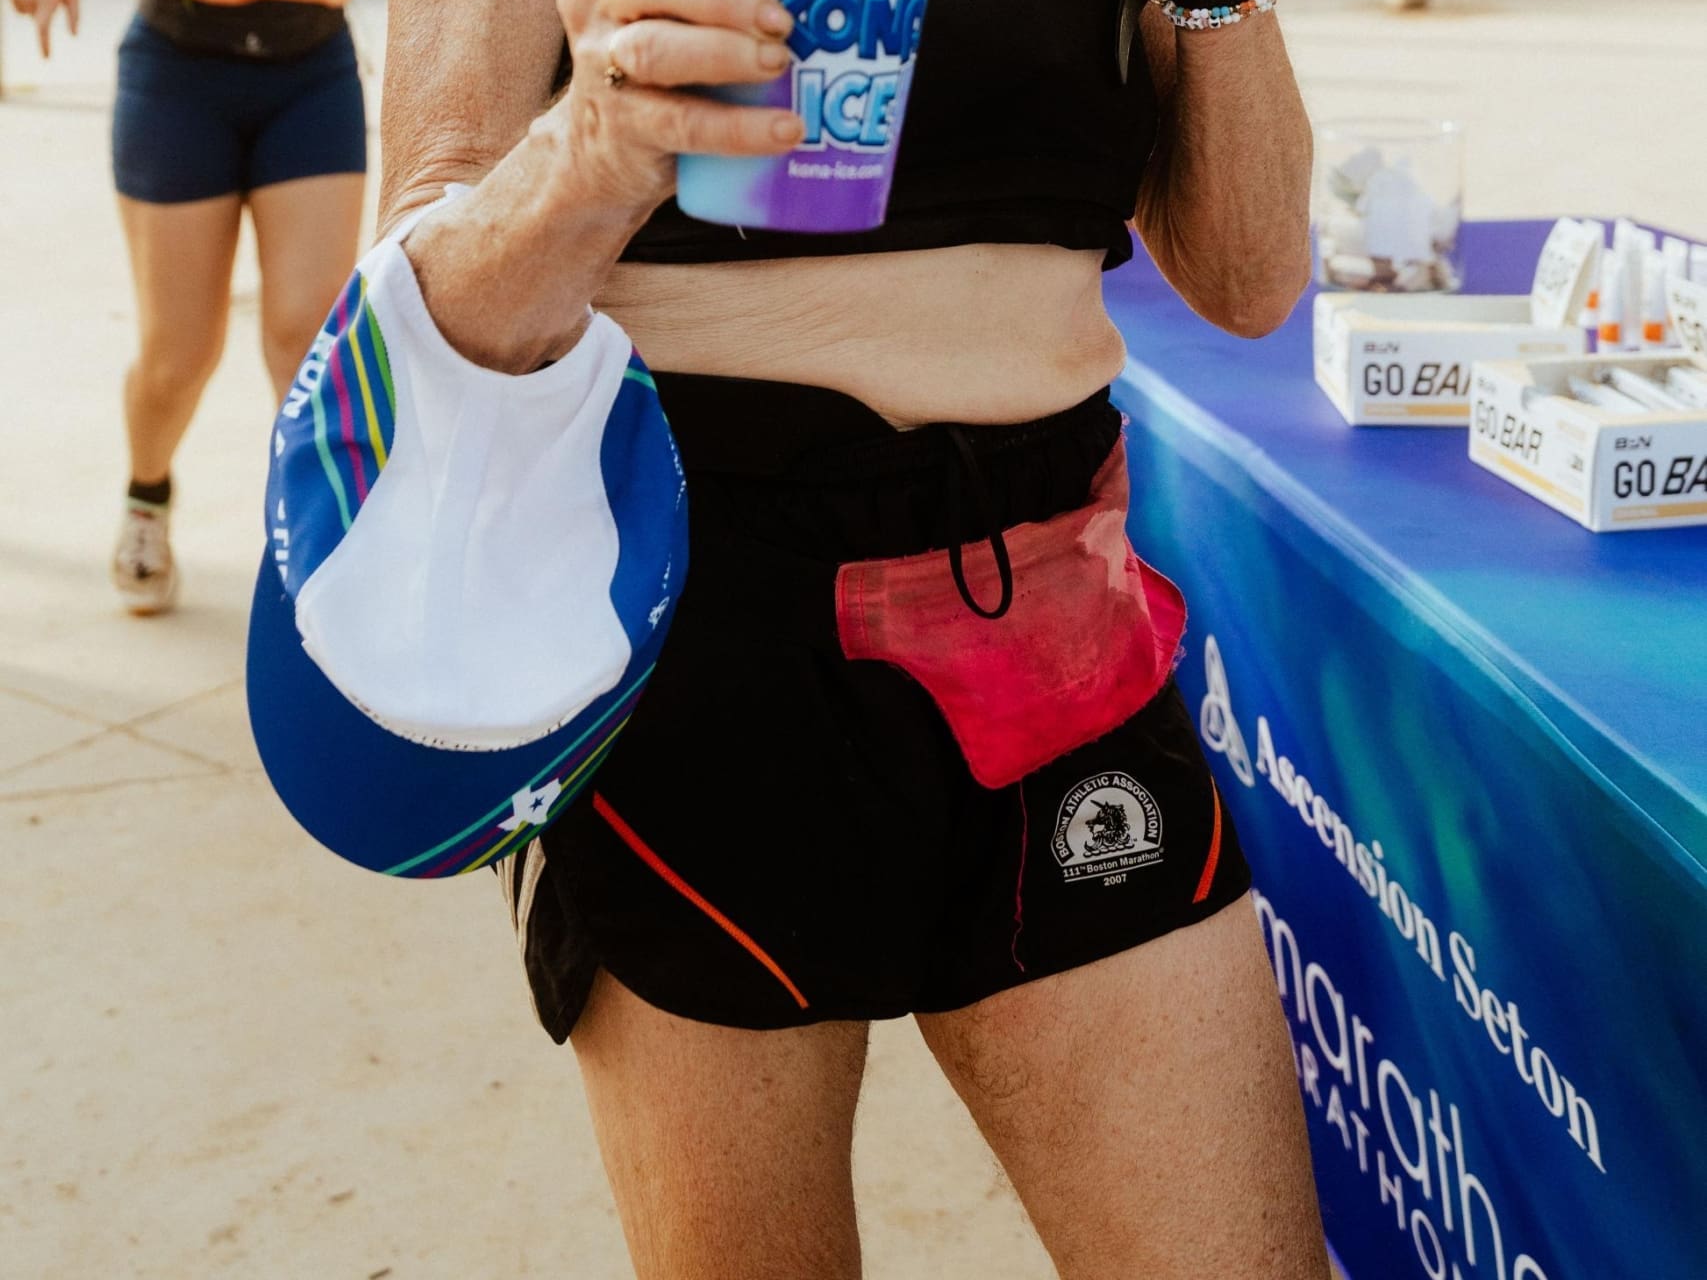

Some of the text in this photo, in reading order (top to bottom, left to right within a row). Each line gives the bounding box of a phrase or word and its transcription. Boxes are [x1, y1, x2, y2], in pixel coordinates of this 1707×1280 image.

[797, 70, 901, 146] ICE
[1364, 363, 1405, 397] GO
[1500, 412, 1544, 465] BAR
[1613, 459, 1656, 500] GO
[1065, 776, 1110, 816] ATHLETIC
[1112, 775, 1159, 839] ASSOCIATION
[1086, 858, 1119, 874] Boston
[1103, 873, 1127, 887] 2007
[1256, 716, 1607, 1174] Ascension Seton
[1289, 1026, 1464, 1280] RATHO
